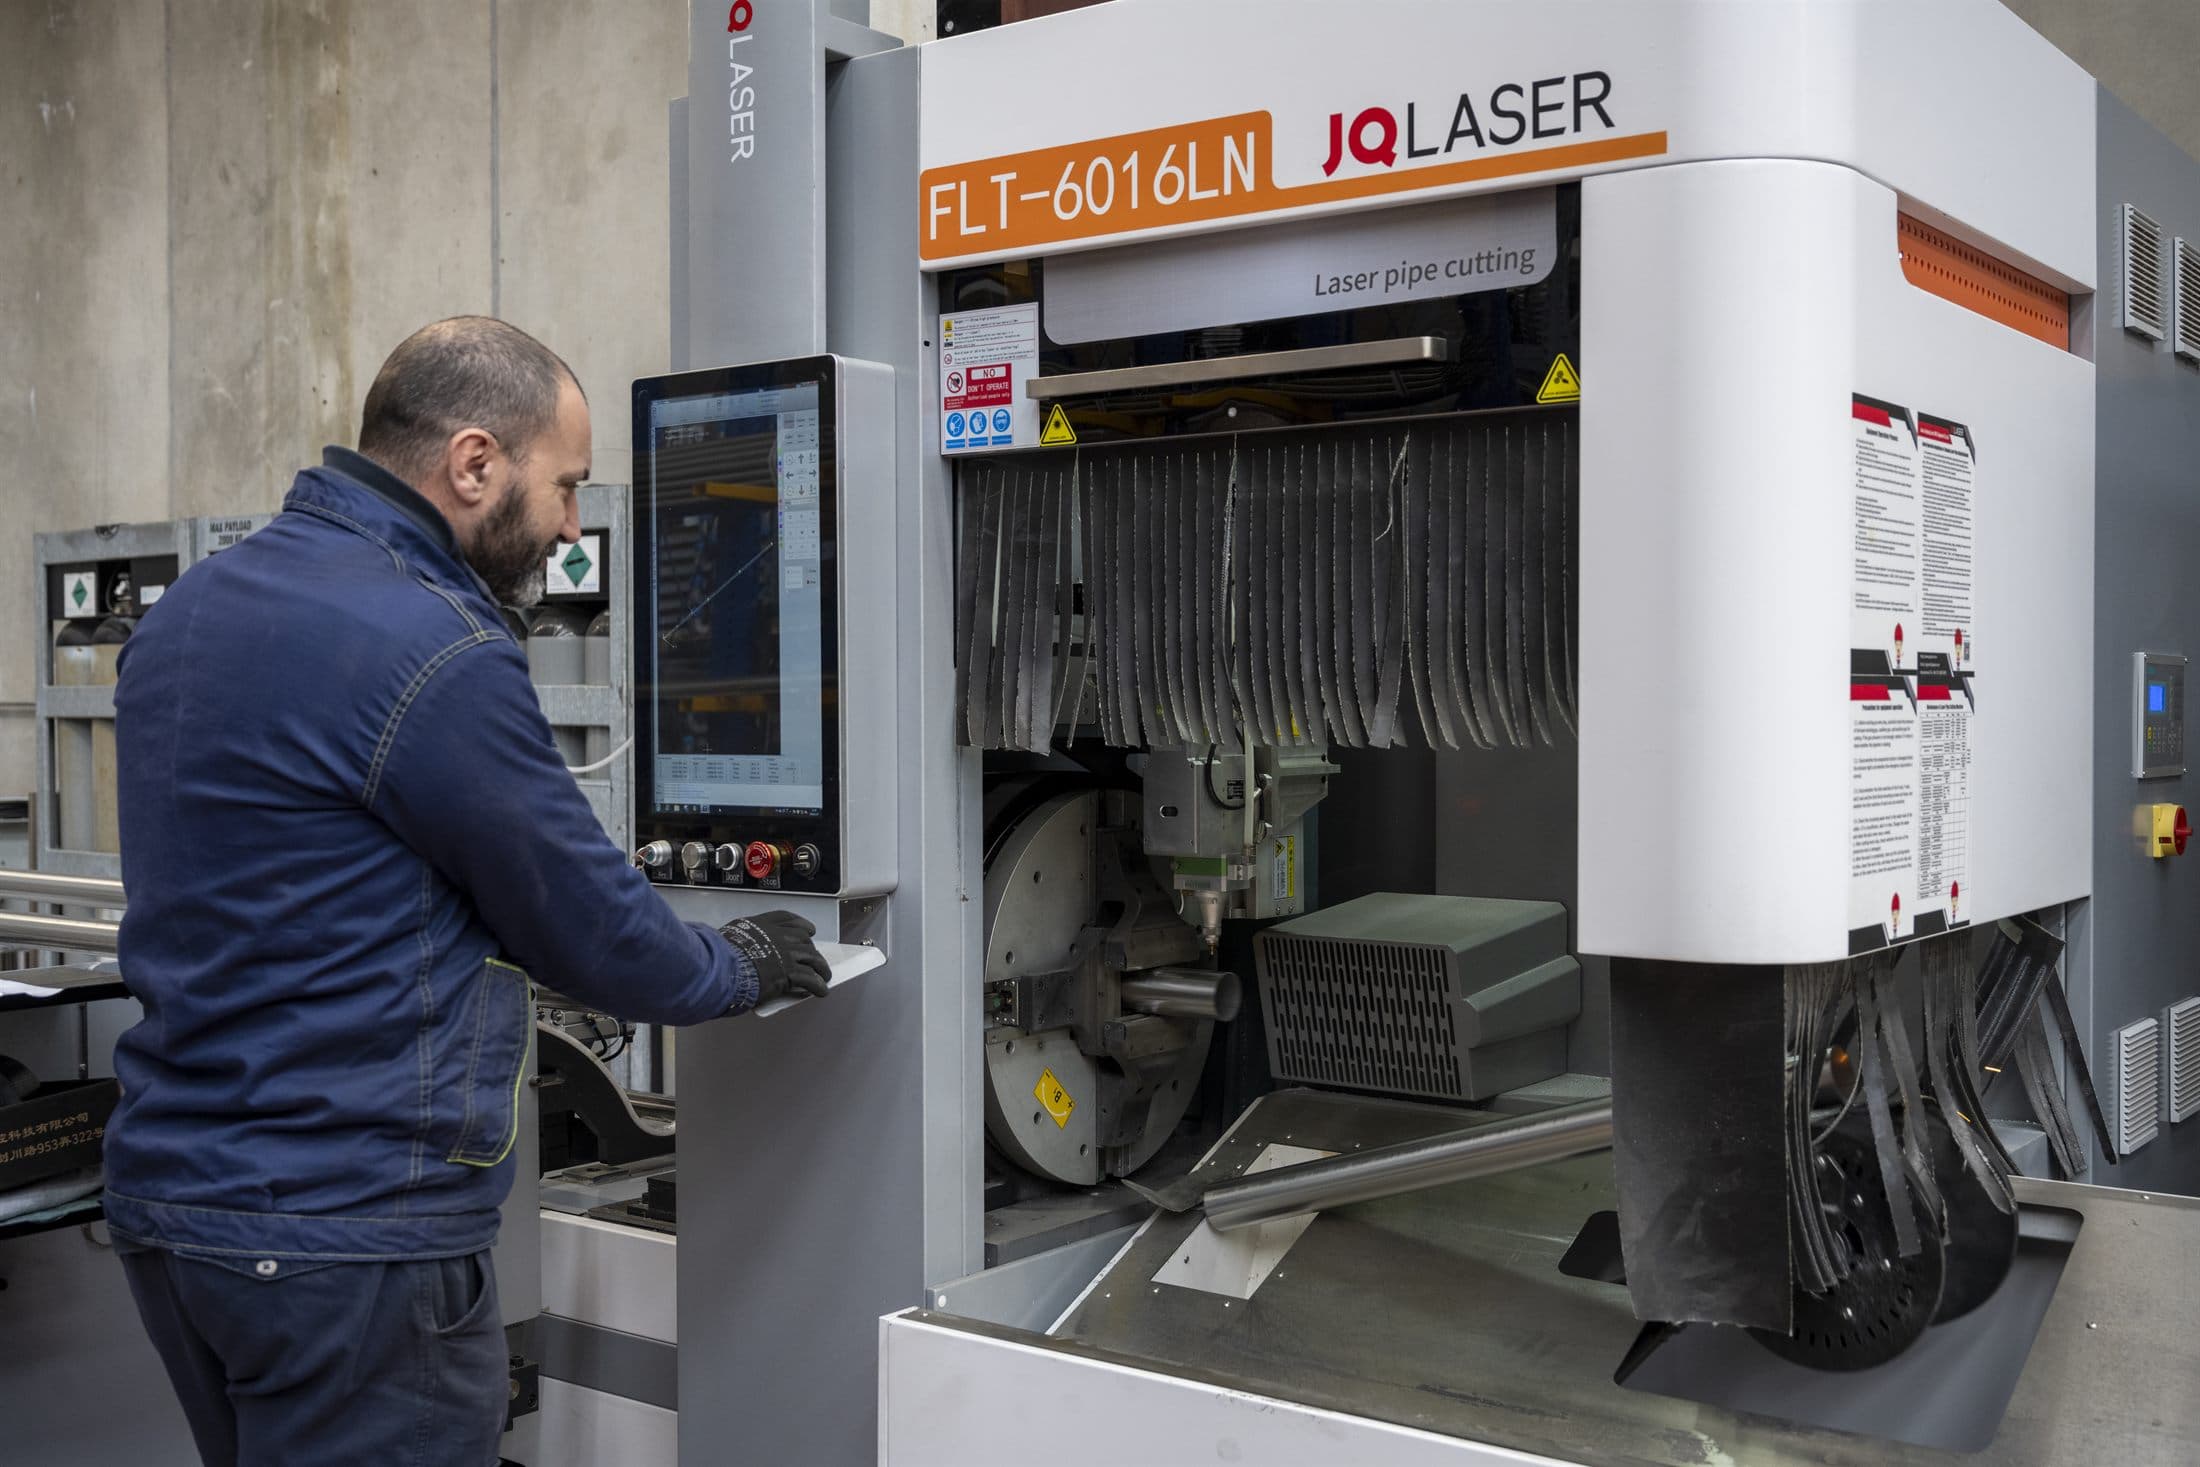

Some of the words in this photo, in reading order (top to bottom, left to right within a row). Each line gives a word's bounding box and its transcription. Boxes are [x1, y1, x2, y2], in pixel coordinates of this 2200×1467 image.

[929, 131, 1256, 240] FLT-6016LN
[1314, 268, 1380, 297] Laser
[1384, 259, 1438, 293] pipe
[1444, 247, 1536, 275] cutting
[982, 368, 996, 378] NO
[967, 382, 984, 393] DON'T
[986, 381, 1009, 391] OPERATE
[725, 872, 740, 882] Door
